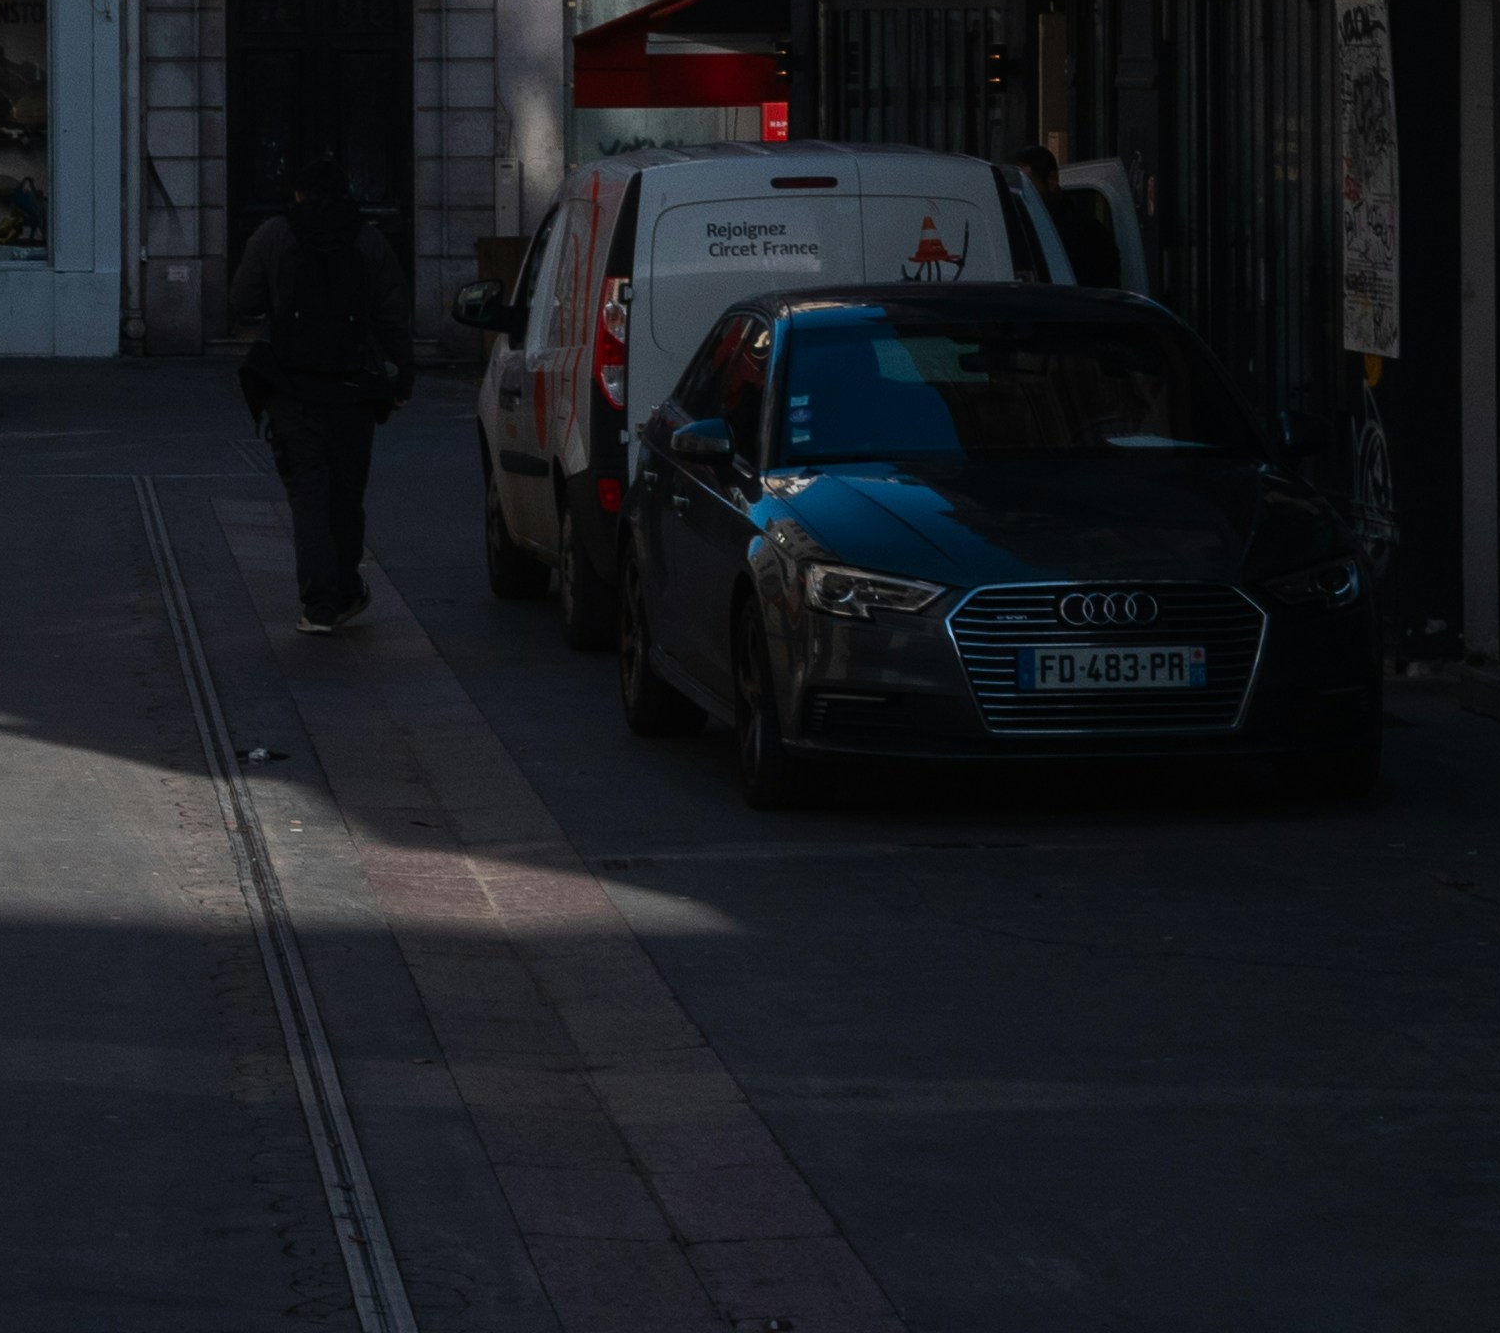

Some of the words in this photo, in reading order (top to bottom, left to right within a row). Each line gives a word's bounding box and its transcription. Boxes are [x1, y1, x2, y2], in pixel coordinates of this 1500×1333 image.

[707, 223, 787, 240] Rejoignez
[709, 242, 758, 257] Circet
[763, 241, 818, 256] France
[1039, 651, 1185, 684] FD-483-PR
